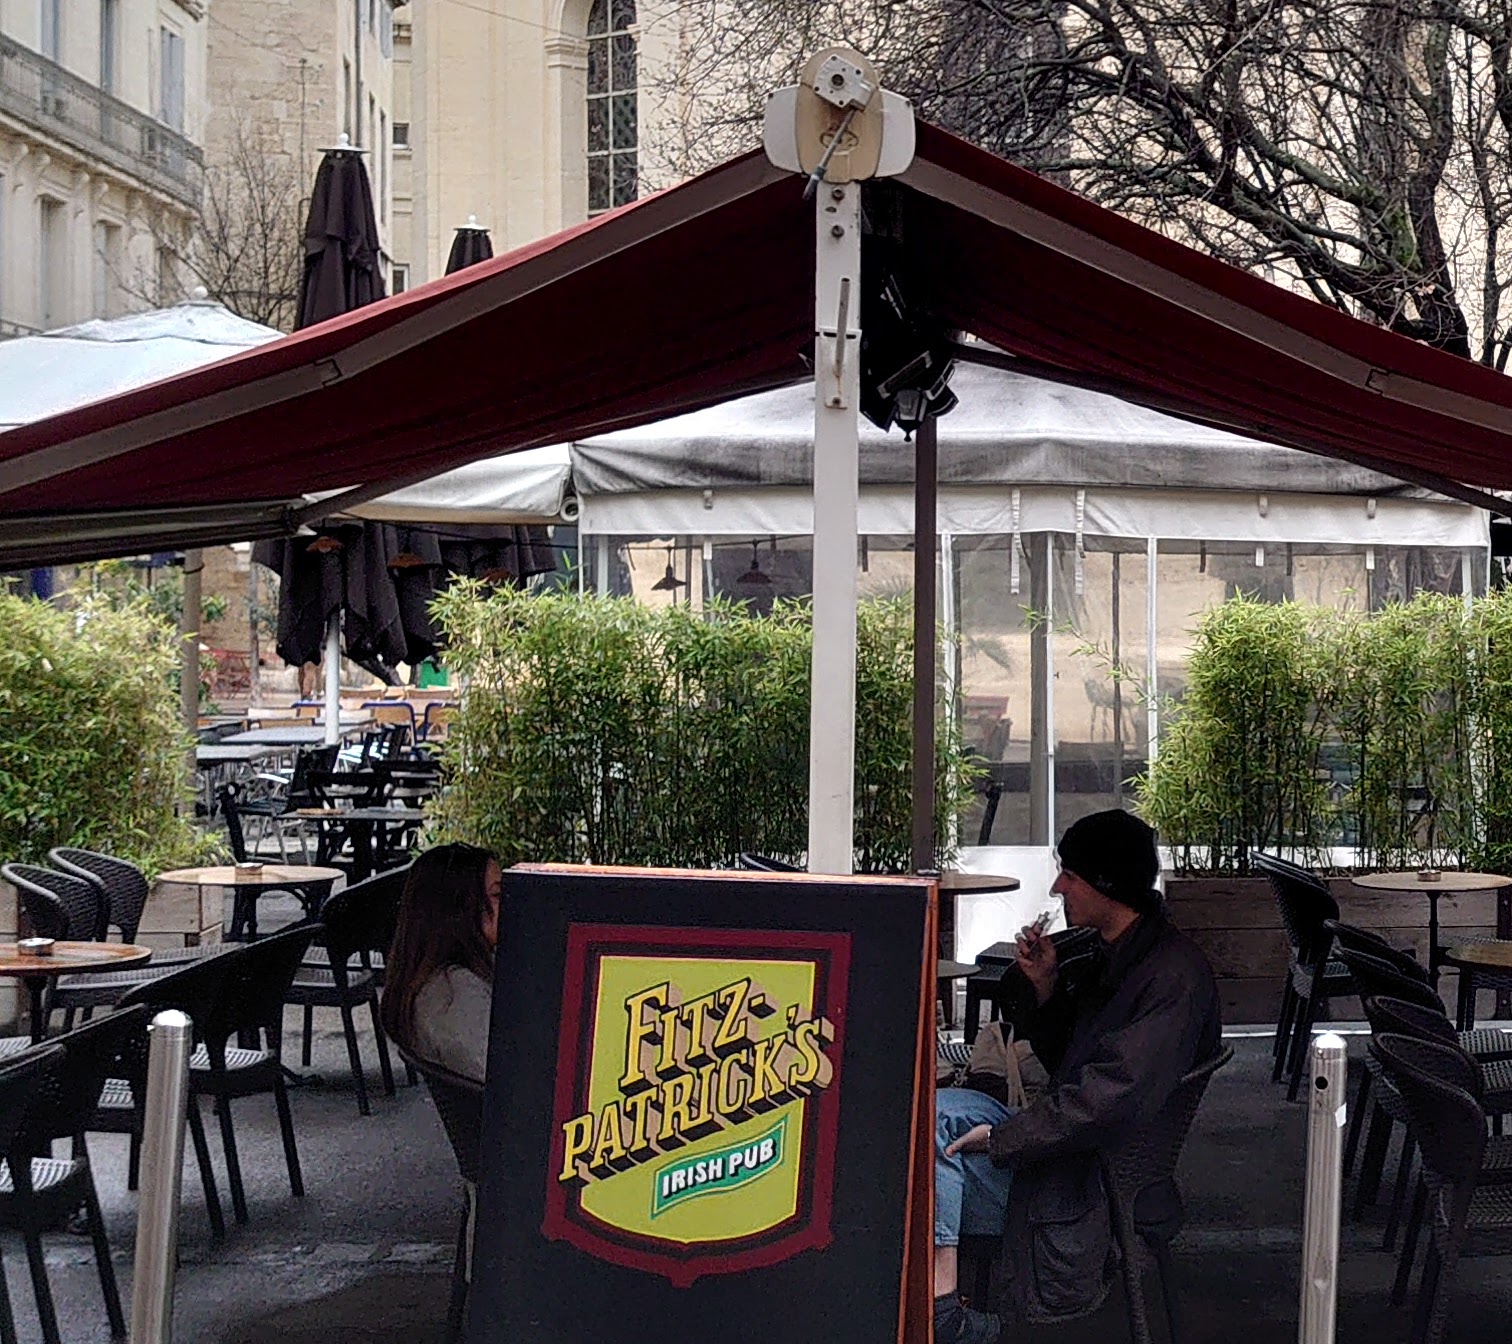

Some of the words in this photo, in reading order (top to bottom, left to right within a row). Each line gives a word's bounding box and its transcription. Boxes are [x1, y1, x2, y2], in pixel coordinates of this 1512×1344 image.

[558, 1004, 822, 1181] PATRICK'S
[661, 1159, 723, 1196] IRISH
[728, 1137, 775, 1169] PUB
